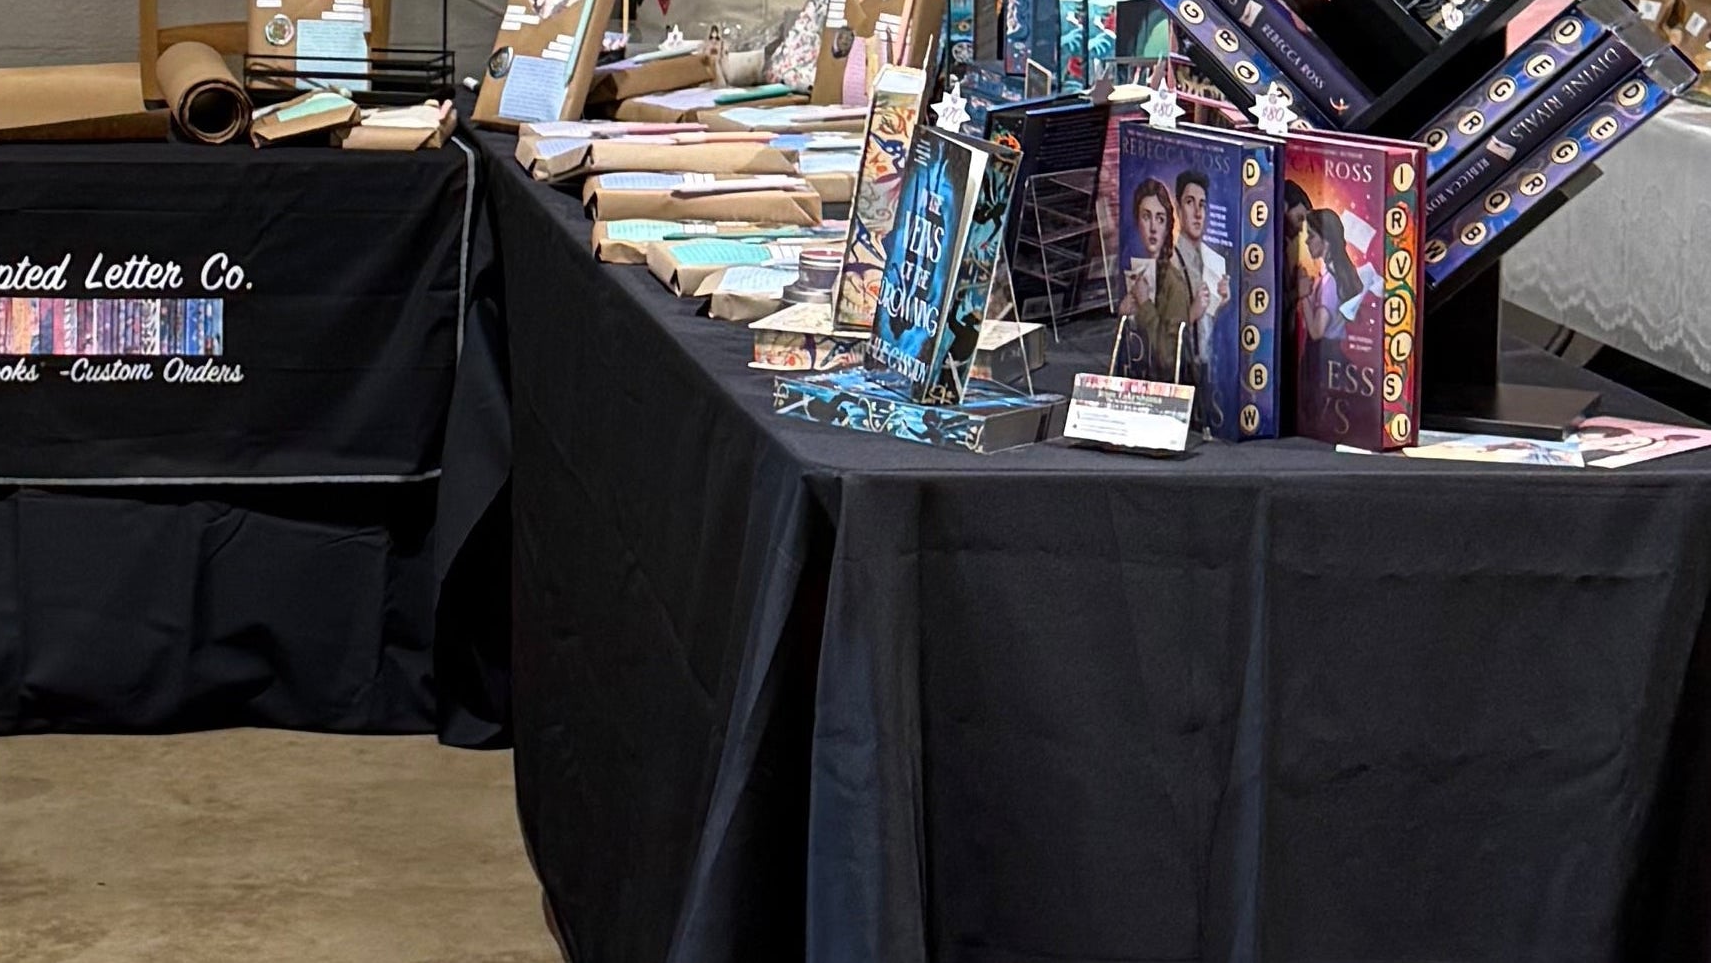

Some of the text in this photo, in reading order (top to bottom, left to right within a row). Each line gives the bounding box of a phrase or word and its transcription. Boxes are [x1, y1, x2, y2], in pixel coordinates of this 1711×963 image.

[1261, 24, 1326, 89] REBECCA ROSS
[1510, 47, 1621, 142] DIVINE RIVALS
[941, 106, 962, 123] $70
[1153, 104, 1174, 117] $80
[1262, 107, 1285, 121] $80
[1121, 137, 1186, 161] REBECCA
[1191, 150, 1231, 174] ROSS
[1324, 159, 1373, 183] ROSS
[1444, 157, 1490, 199] REBECCA
[85, 253, 184, 290] Letter
[200, 253, 253, 290] Co.
[60, 360, 153, 382] -Custom
[163, 358, 245, 383] Orders
